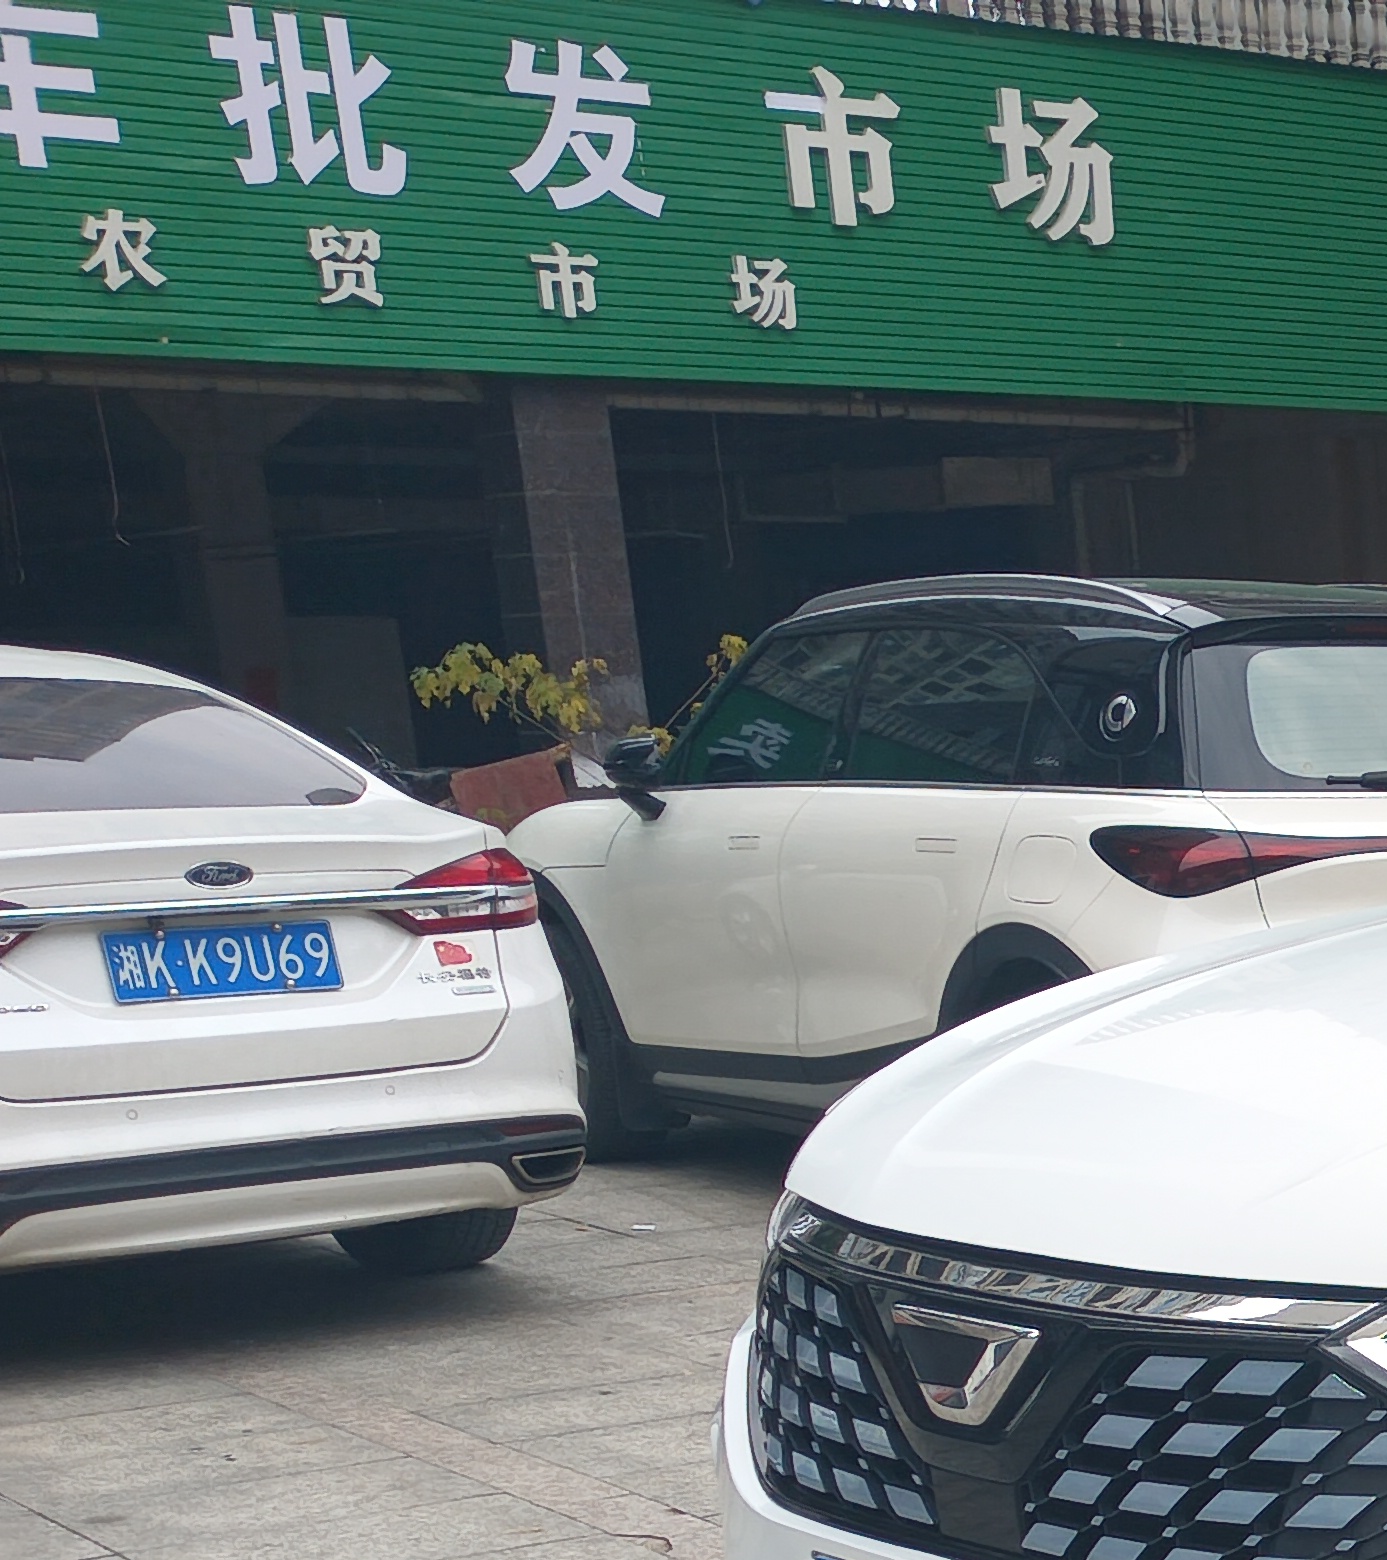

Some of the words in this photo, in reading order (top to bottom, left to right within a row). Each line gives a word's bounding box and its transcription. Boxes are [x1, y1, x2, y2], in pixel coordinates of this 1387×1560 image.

[80, 208, 798, 330] 农贸市场
[201, 865, 240, 887] Ford
